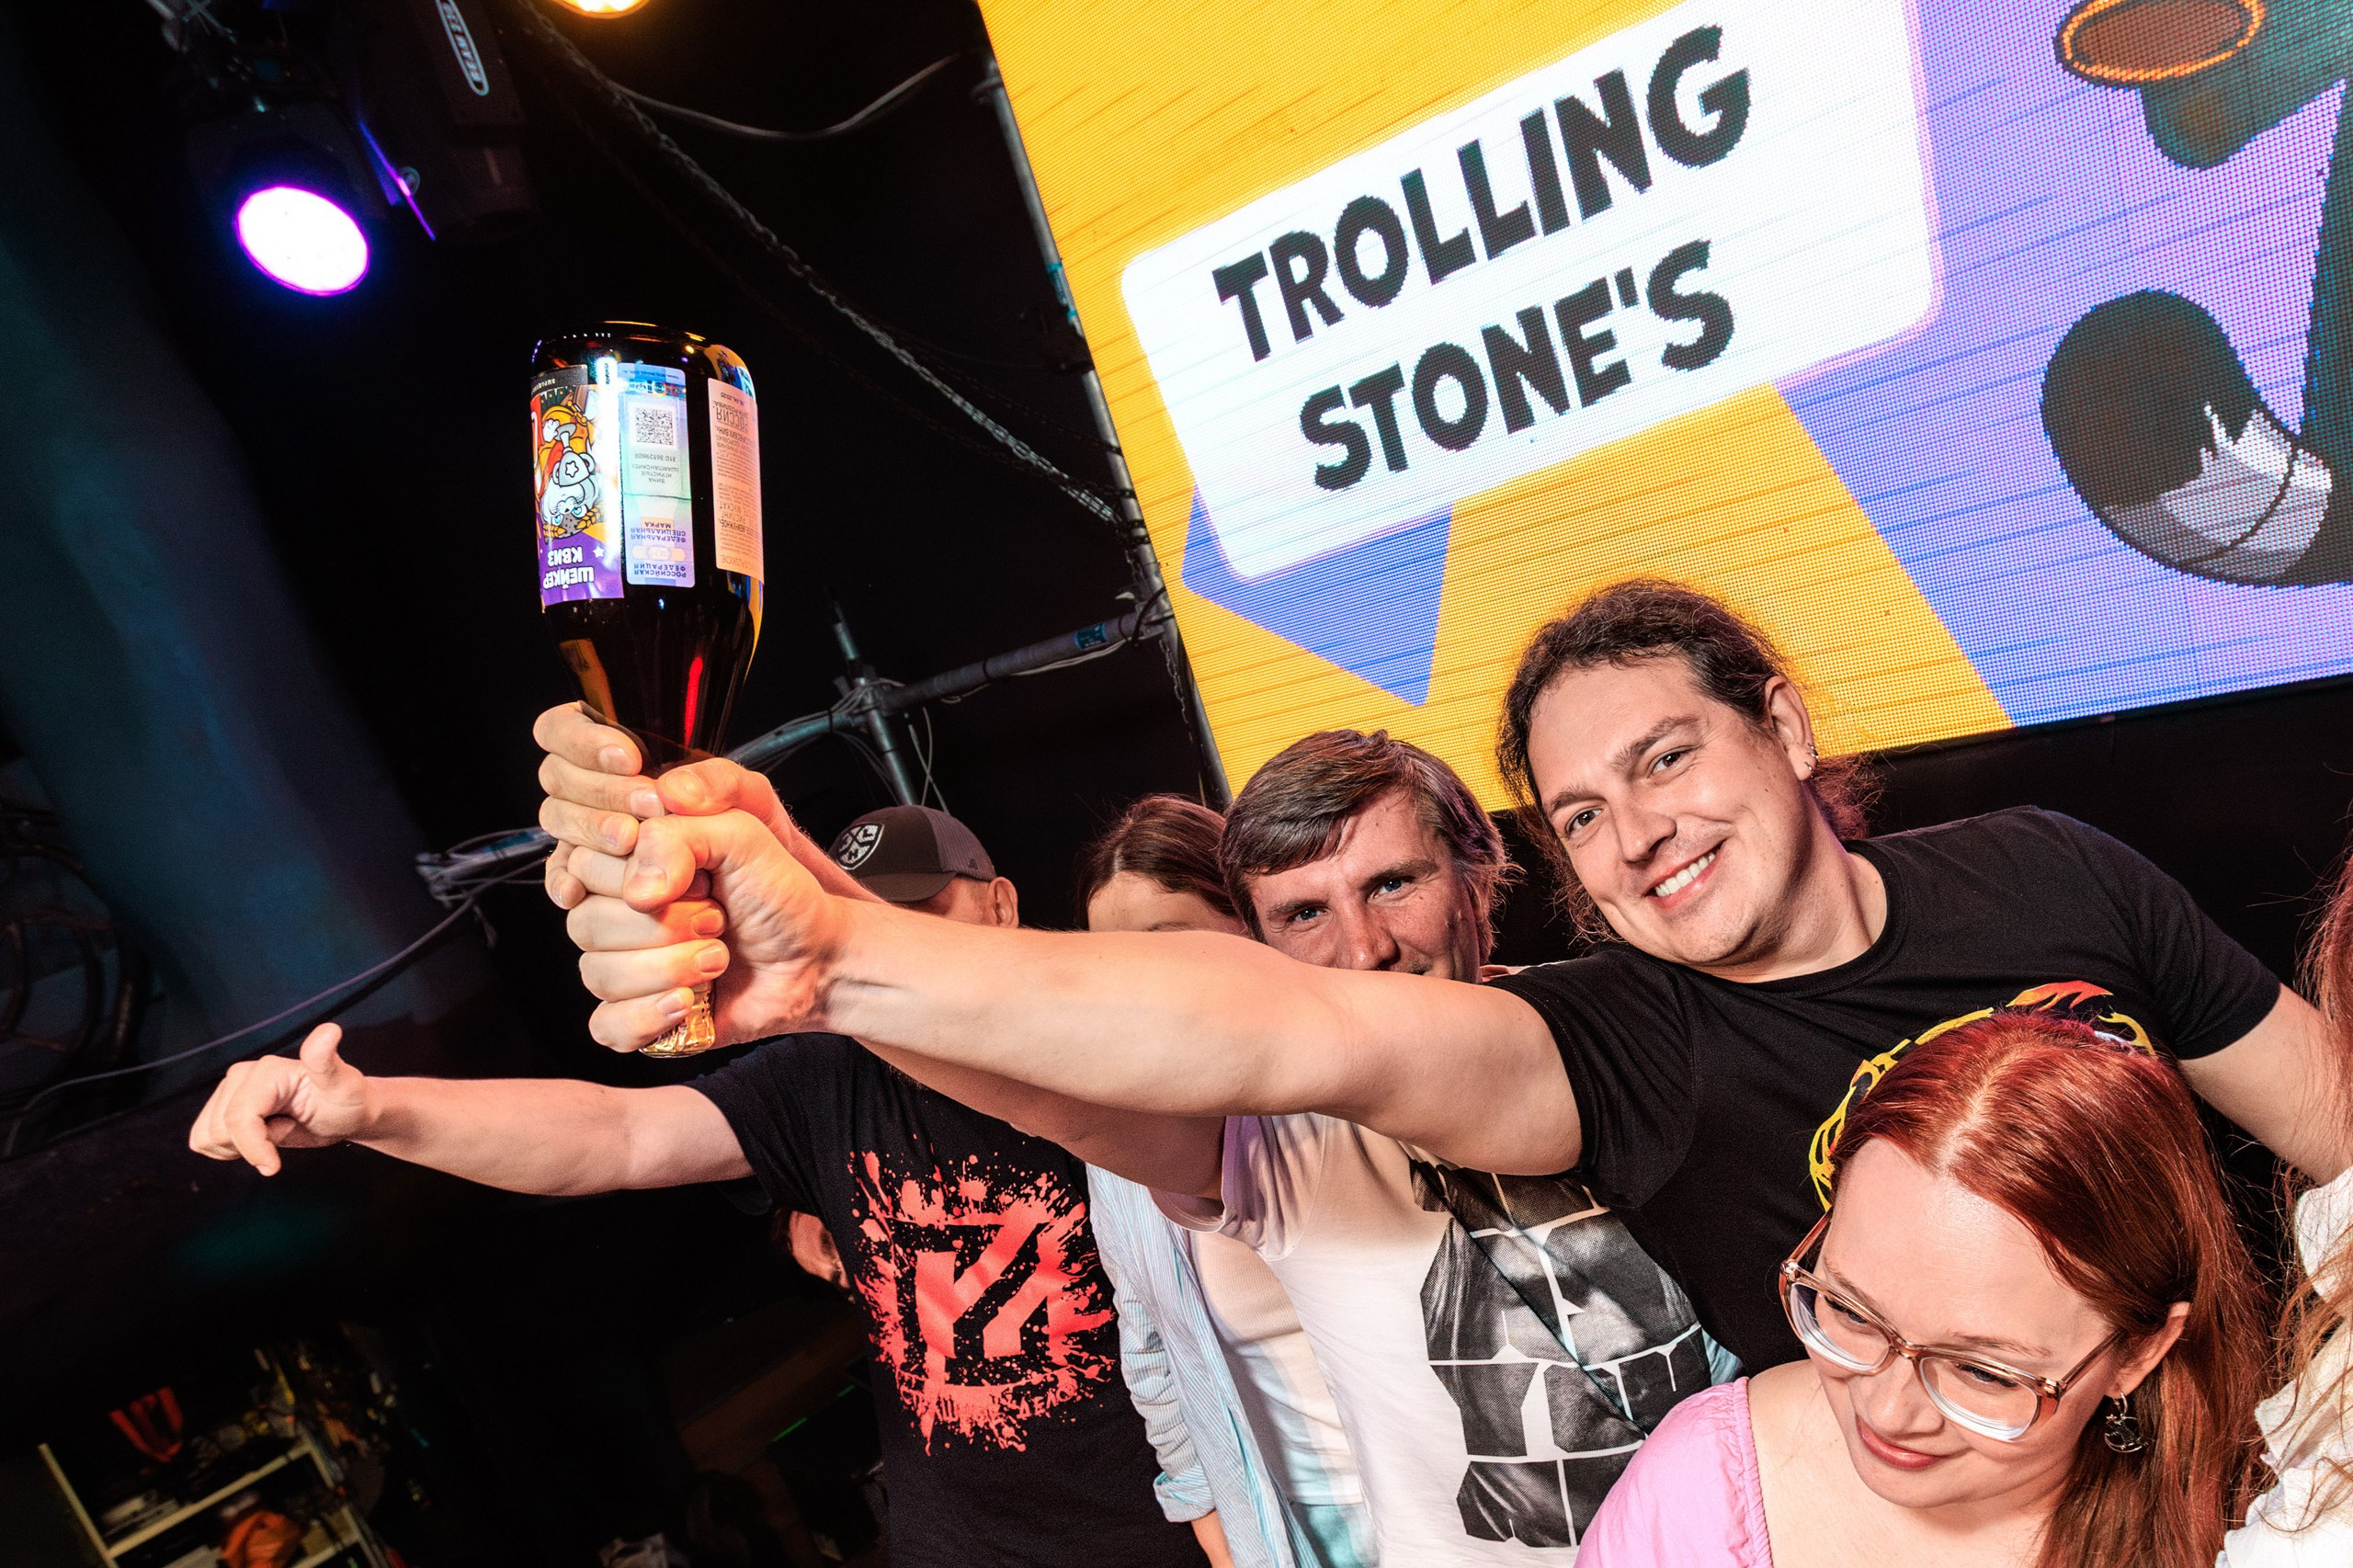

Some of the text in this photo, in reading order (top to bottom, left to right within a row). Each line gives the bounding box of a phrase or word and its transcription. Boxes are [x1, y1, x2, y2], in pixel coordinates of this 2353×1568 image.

[1212, 24, 1751, 362] TROLLING
[1300, 239, 1735, 491] STONE'S
[631, 528, 686, 537] СПЕЦИАЛЬНАЯ
[631, 533, 687, 542] ФЕДЕРАЛЬНАЯ
[548, 546, 584, 567] КВИЗ
[633, 562, 687, 572] ФЕДЕРАЦИЯ
[633, 569, 687, 578] РОССИЙСКАЯ
[543, 566, 595, 590] ШЕЙКЕР
